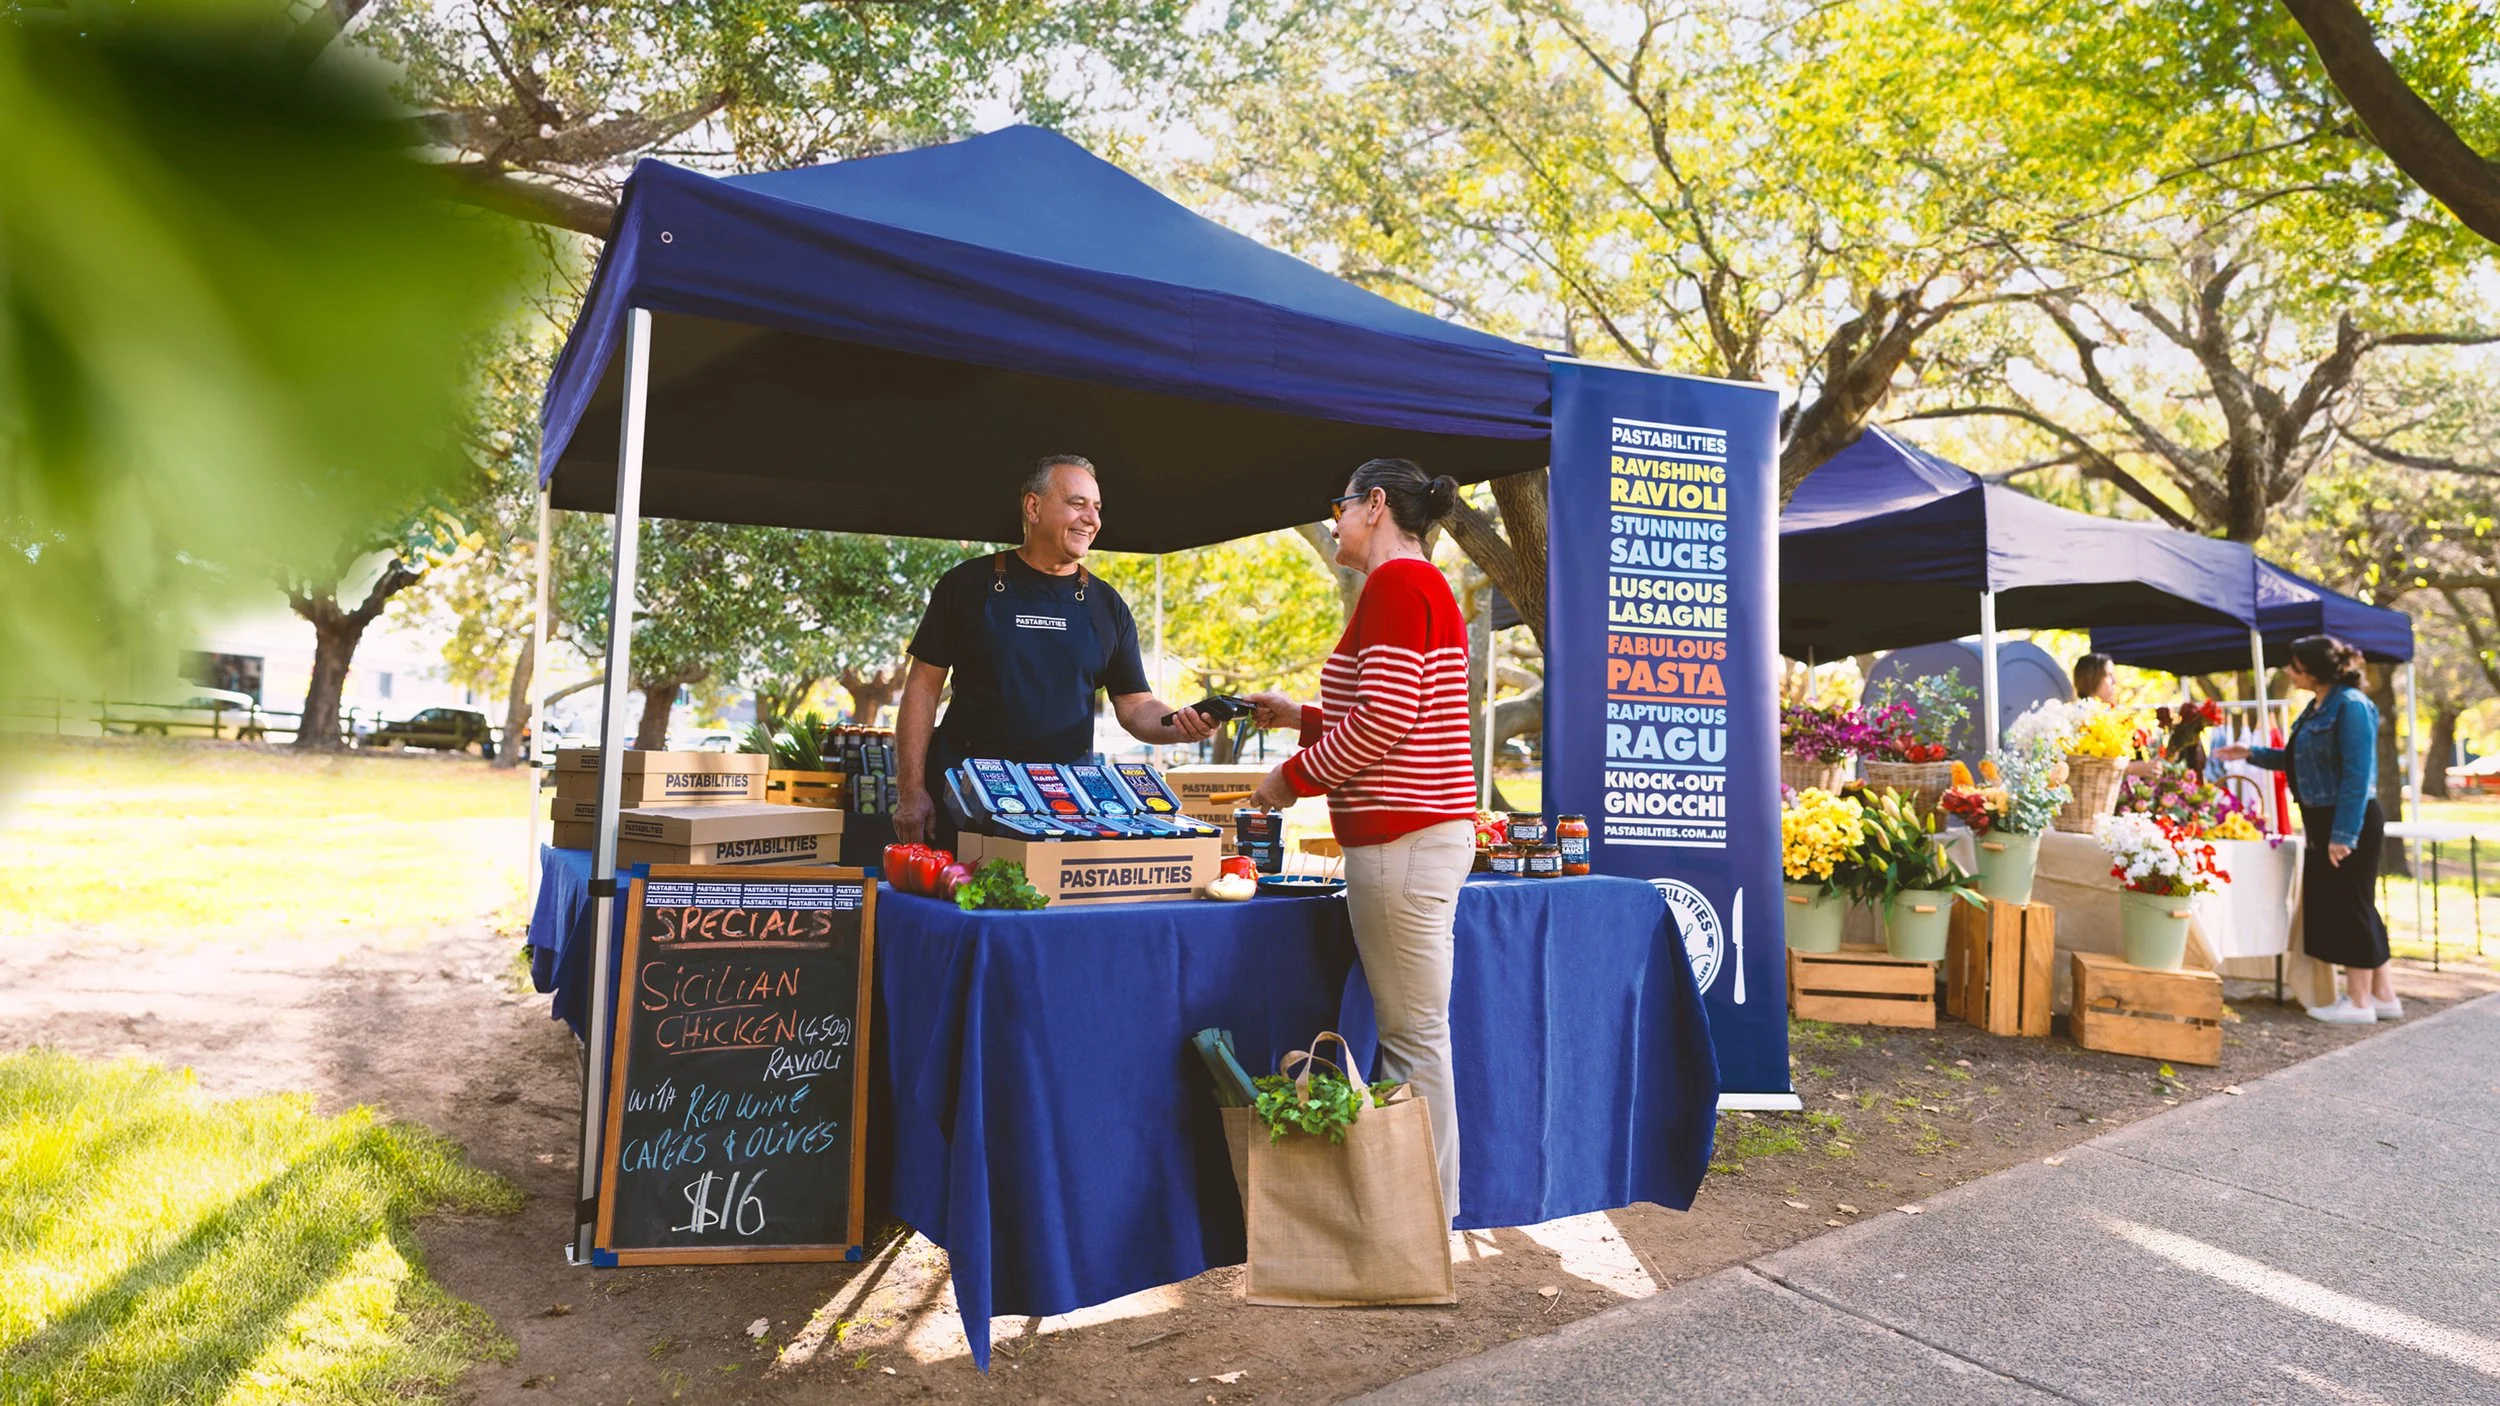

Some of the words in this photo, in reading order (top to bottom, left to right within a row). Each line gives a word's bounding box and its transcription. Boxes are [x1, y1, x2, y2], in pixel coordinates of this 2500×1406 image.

[1611, 456, 1726, 484] RAVISHING
[1611, 477, 1727, 511] RAVIOLI
[1611, 515, 1727, 542] STUNNING
[1610, 538, 1727, 570] SAUCES
[1609, 576, 1727, 604] LUSCIOUS
[1609, 600, 1727, 629] LASAGNE
[1608, 635, 1727, 660] FABULOUS
[1607, 658, 1727, 696] PASTA
[1607, 703, 1727, 725] RAPTUROUS
[1606, 724, 1727, 763] RAGU
[1604, 771, 1726, 792] KNOCK-OUT
[1604, 791, 1726, 818] GNOCCHI
[1604, 825, 1727, 839] PASTABILITIES.COM.AU
[651, 907, 833, 942] SPECIALS
[798, 1014, 851, 1046] (450g)
[622, 1128, 707, 1173] CAPERS
[671, 1168, 768, 1236] $16
